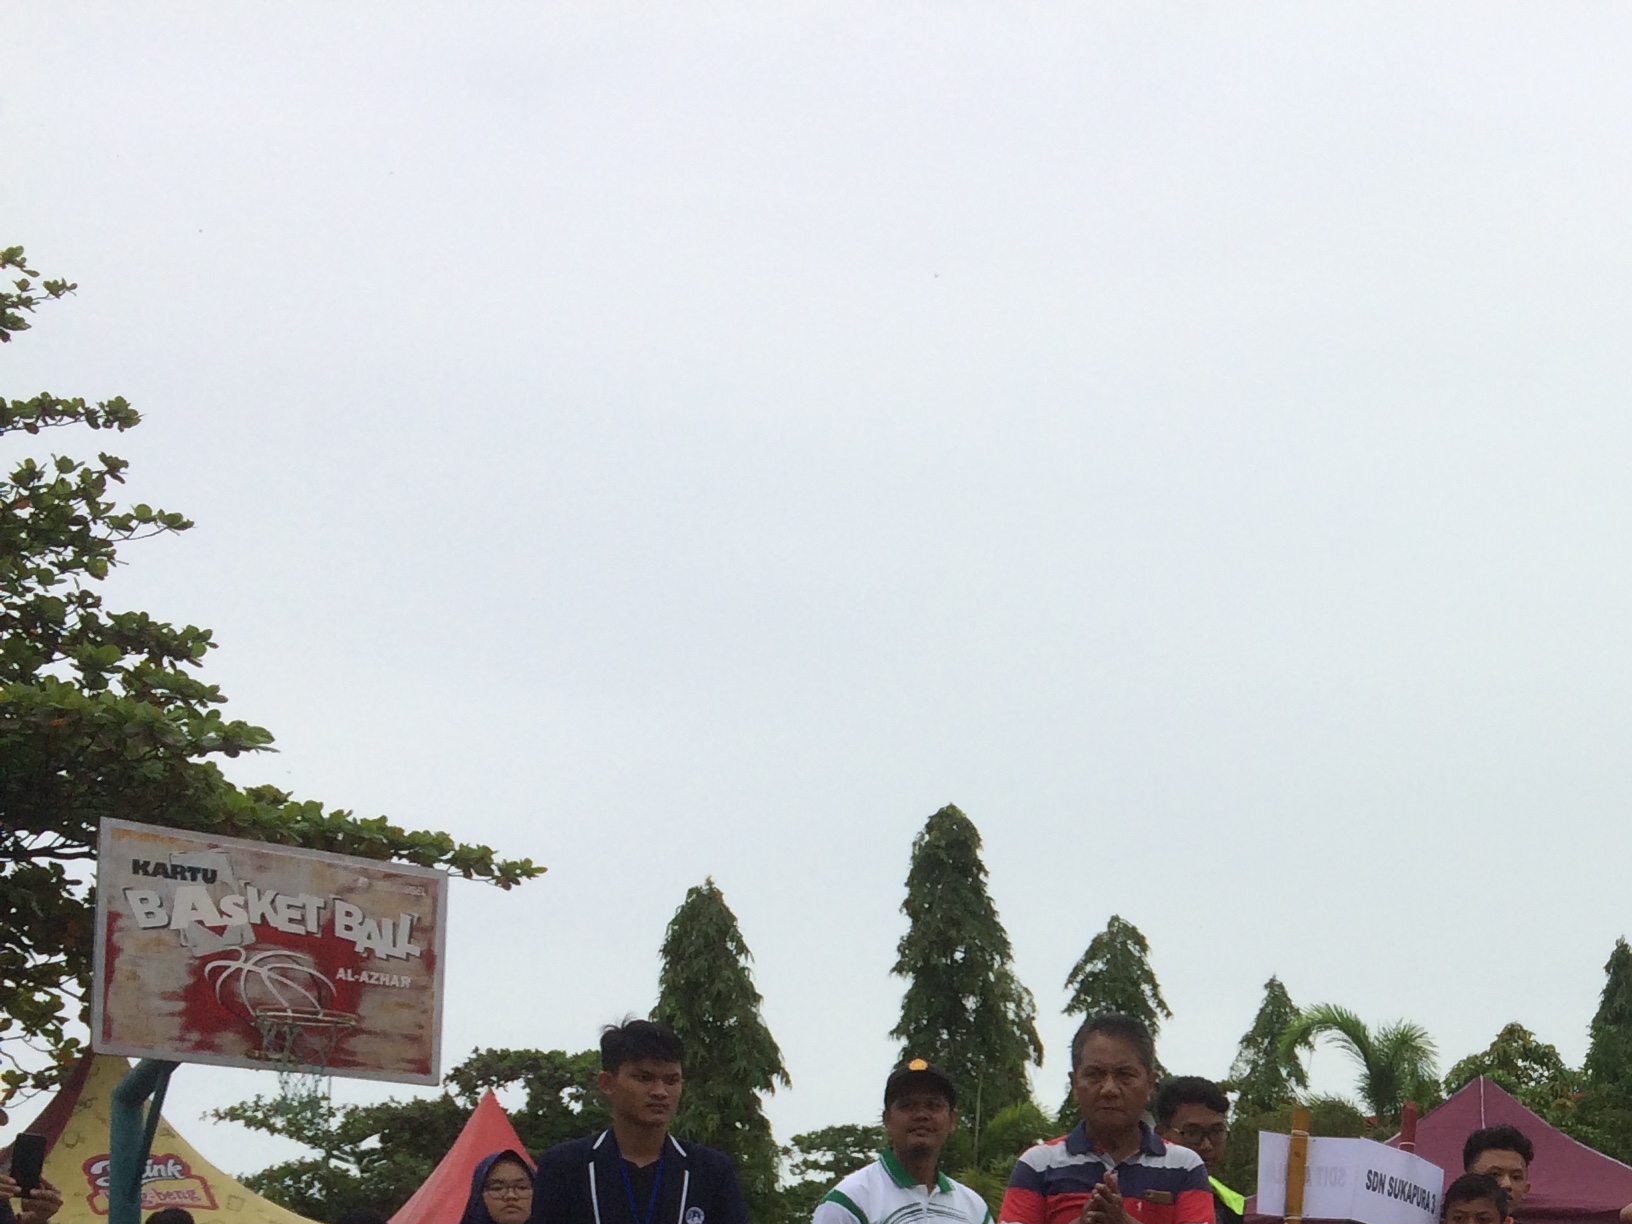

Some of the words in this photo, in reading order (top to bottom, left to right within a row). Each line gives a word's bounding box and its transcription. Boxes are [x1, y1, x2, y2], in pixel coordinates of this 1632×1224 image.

[131, 858, 218, 884] KARTU
[122, 882, 326, 938] BASKET
[332, 893, 421, 962] BALL
[336, 968, 411, 988] AL-AZHAR
[1365, 1169, 1387, 1194] SDN
[1387, 1176, 1431, 1211] SUKAPURA
[1430, 1193, 1437, 1214] 3
